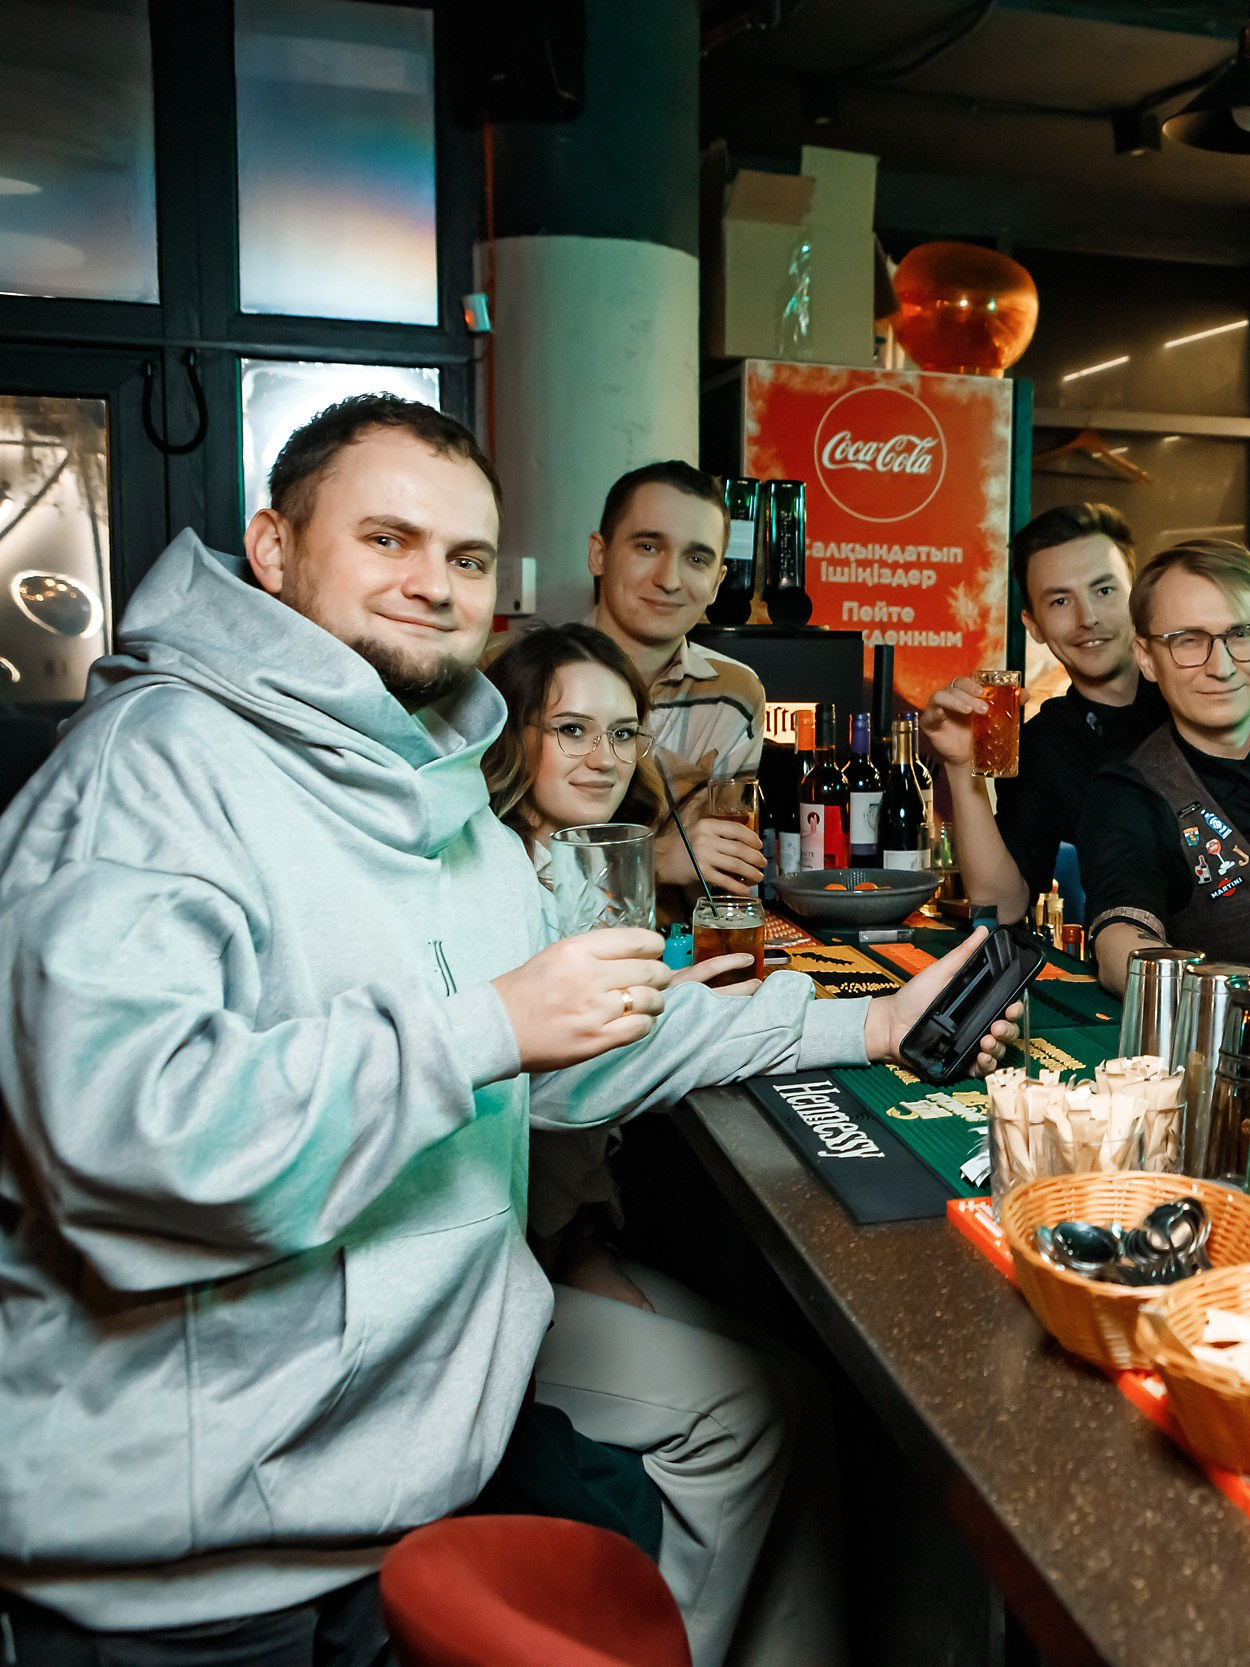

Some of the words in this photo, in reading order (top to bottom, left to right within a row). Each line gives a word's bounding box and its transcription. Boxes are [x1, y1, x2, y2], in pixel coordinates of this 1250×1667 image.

[821, 430, 939, 474] Coca-Cola
[842, 601, 915, 623] Пейте
[1211, 877, 1243, 899] MARTINI
[773, 1080, 886, 1158] Hennessy
